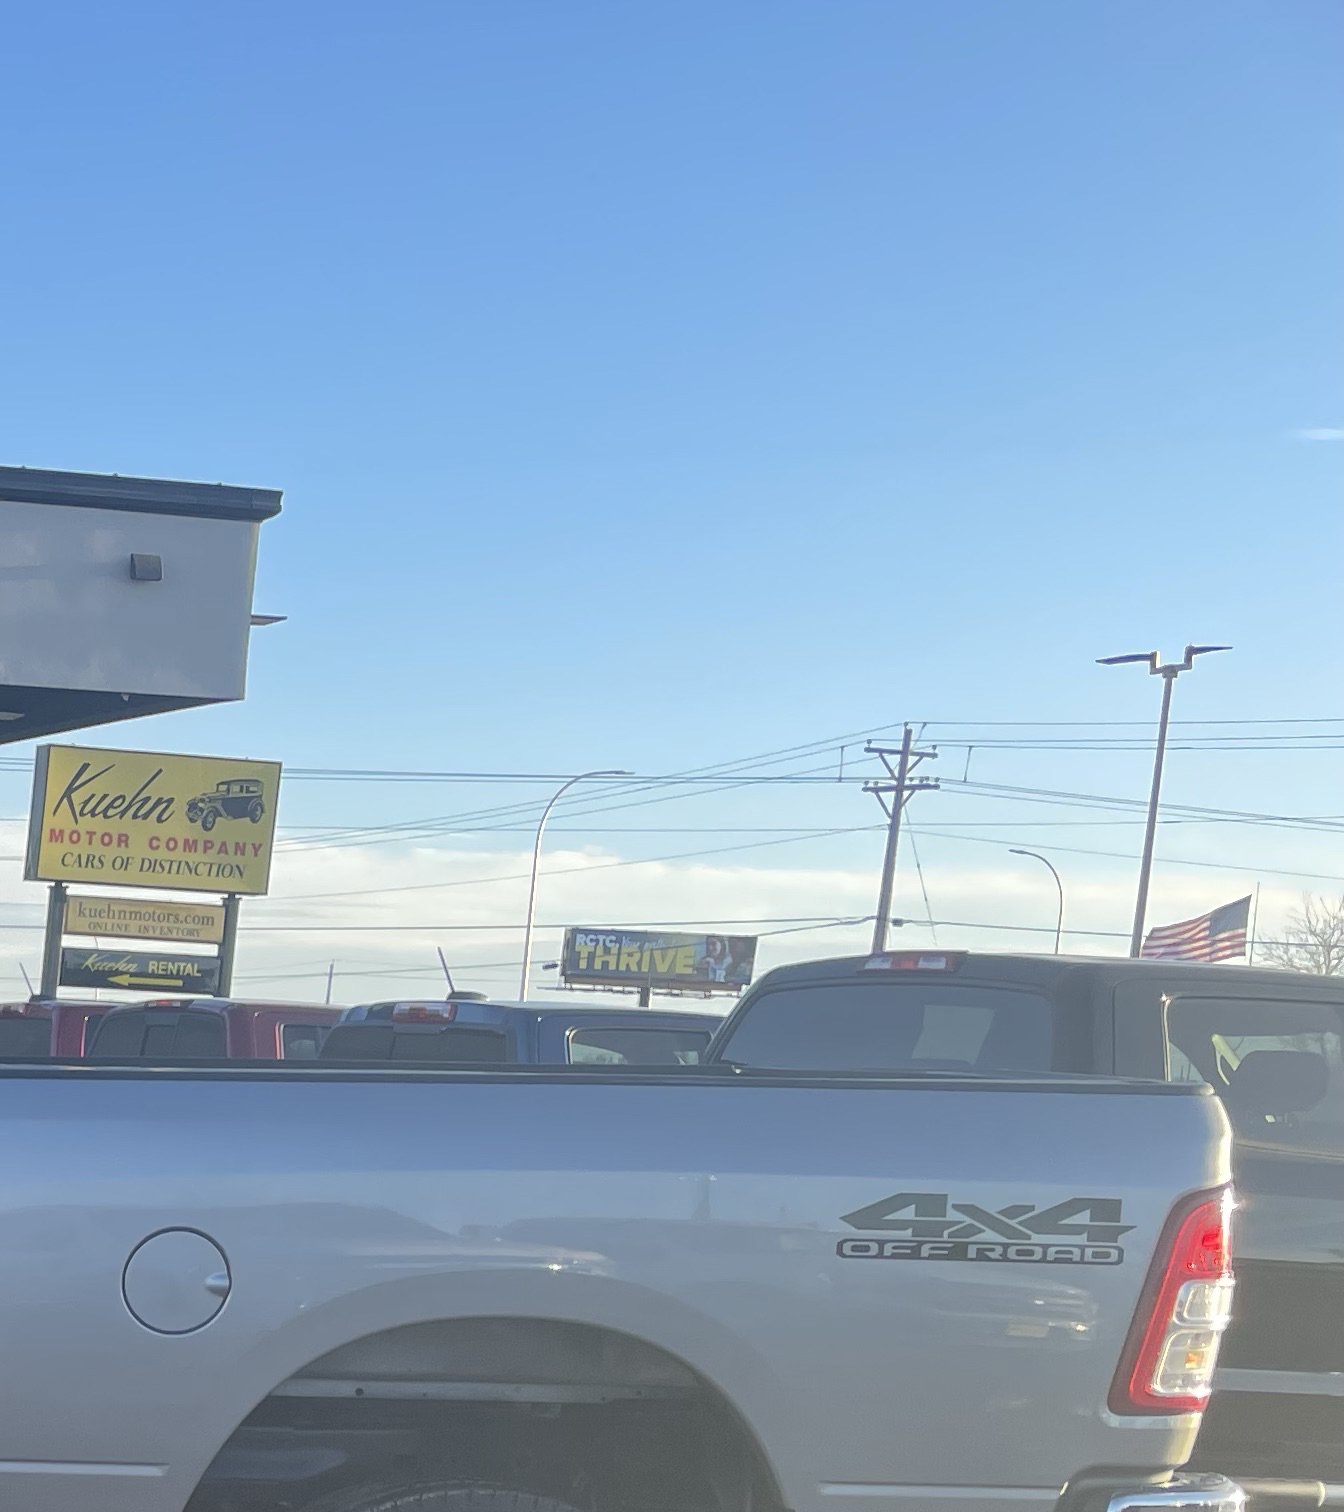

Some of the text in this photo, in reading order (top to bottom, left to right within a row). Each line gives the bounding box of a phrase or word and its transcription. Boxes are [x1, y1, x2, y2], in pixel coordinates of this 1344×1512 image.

[53, 762, 175, 826] Kuehn
[49, 828, 263, 858] MOTOR COMPANY
[61, 851, 246, 880] CARS OF DISTINCTION
[77, 902, 215, 927] kuehnmotors.com
[88, 921, 201, 938] ONLINE INVENTORY
[81, 953, 201, 977] Kuehn RENTAL
[842, 1241, 1120, 1264] OFF ROAD
